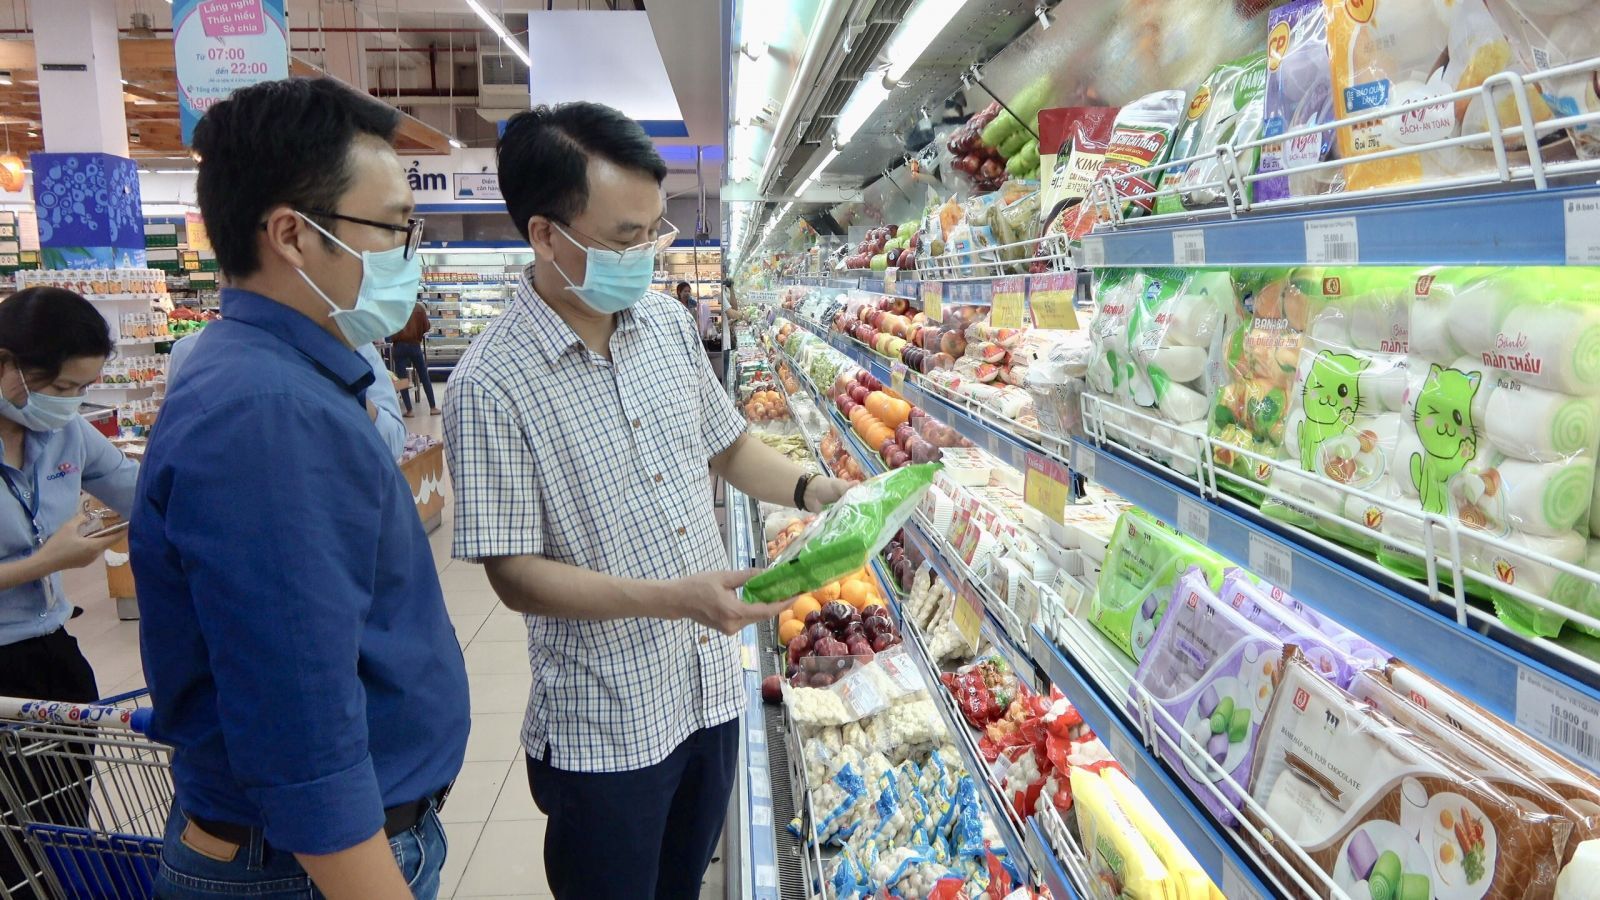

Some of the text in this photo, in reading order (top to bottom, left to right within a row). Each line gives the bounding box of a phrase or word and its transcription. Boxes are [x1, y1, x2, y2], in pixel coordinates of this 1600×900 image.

[208, 13, 232, 24] Thấu
[208, 48, 245, 60] 07:00
[230, 62, 268, 74] 22:00
[1327, 762, 1361, 790] CHOCOLATE
